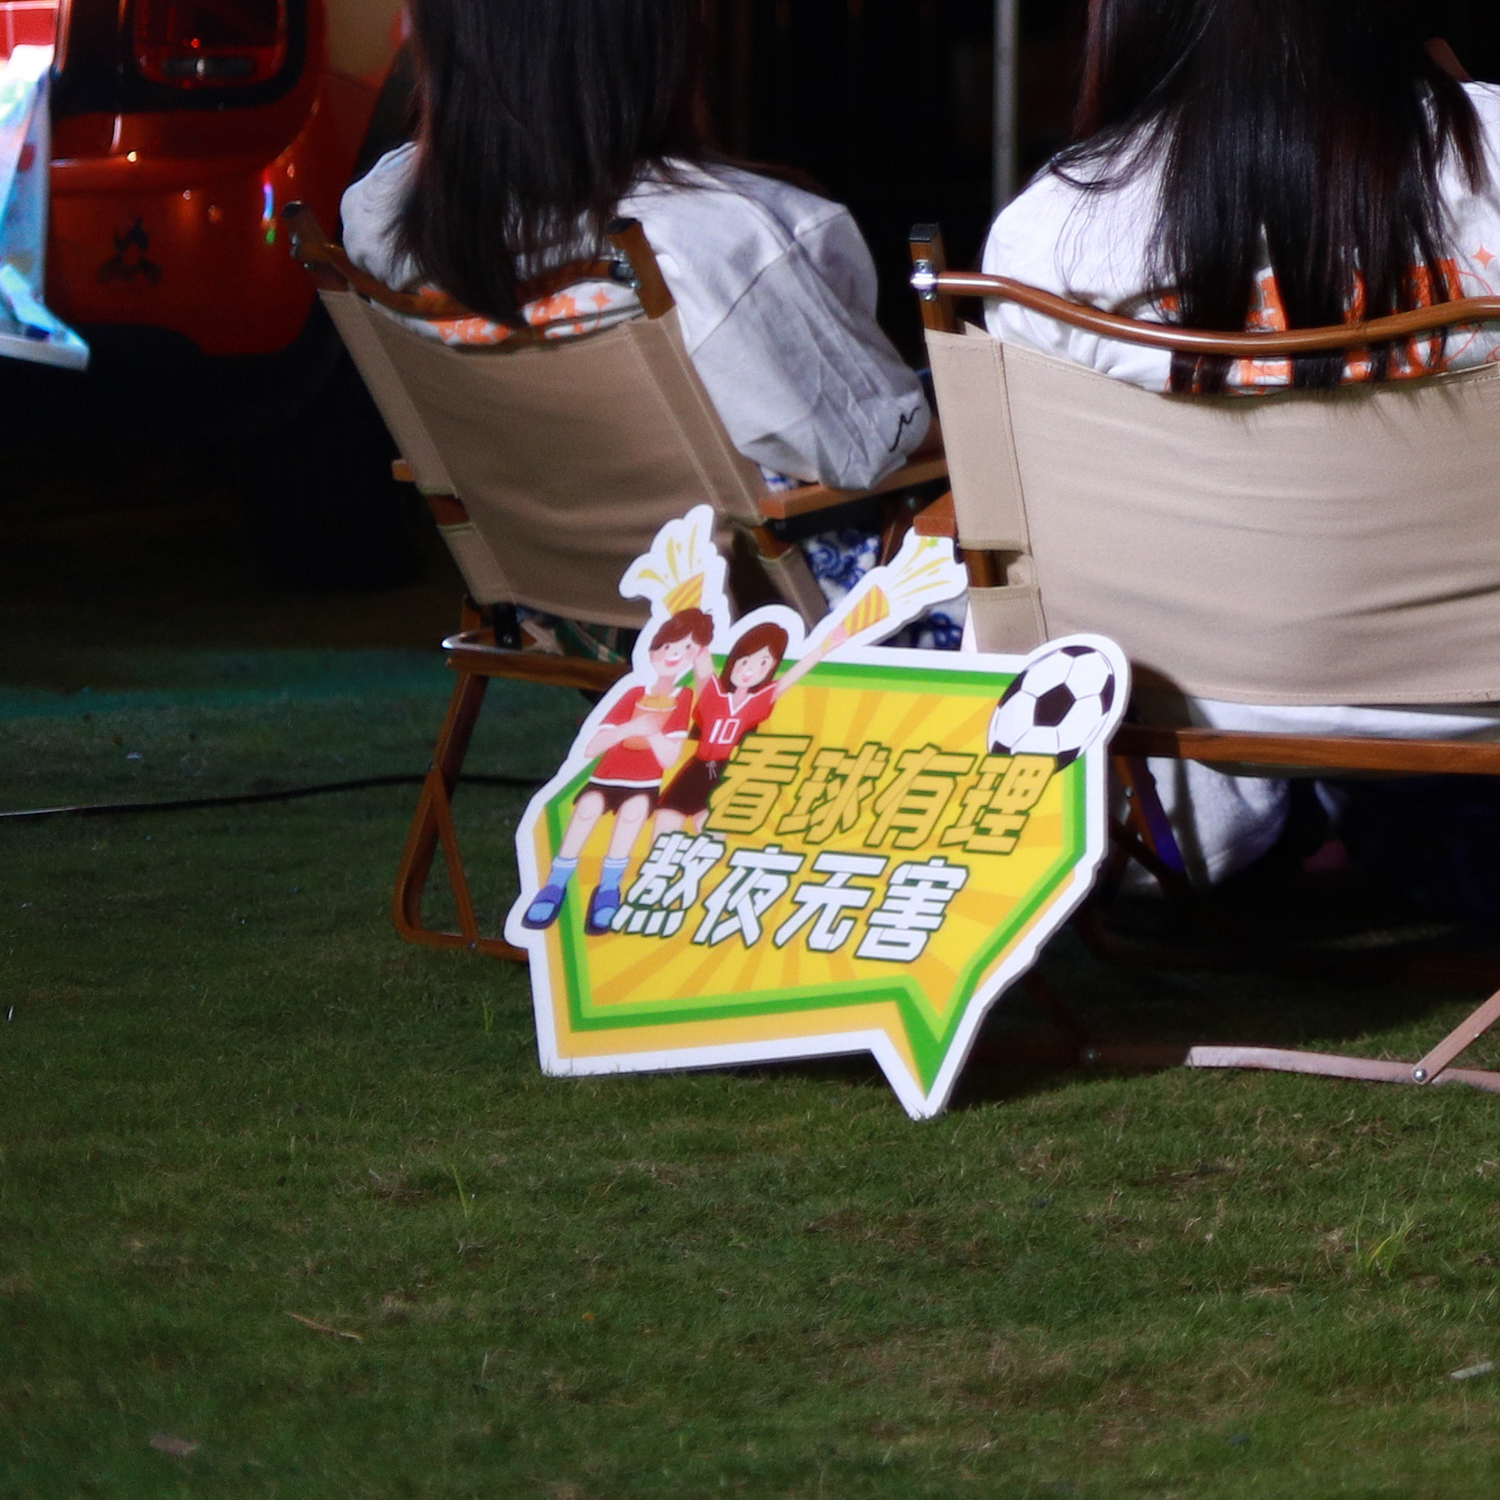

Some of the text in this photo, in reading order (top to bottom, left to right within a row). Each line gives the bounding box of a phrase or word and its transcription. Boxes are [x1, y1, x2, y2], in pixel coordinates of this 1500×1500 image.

[709, 718, 740, 744] 10
[703, 733, 1058, 855] 看球有理
[611, 831, 970, 964] 熬夜无害
